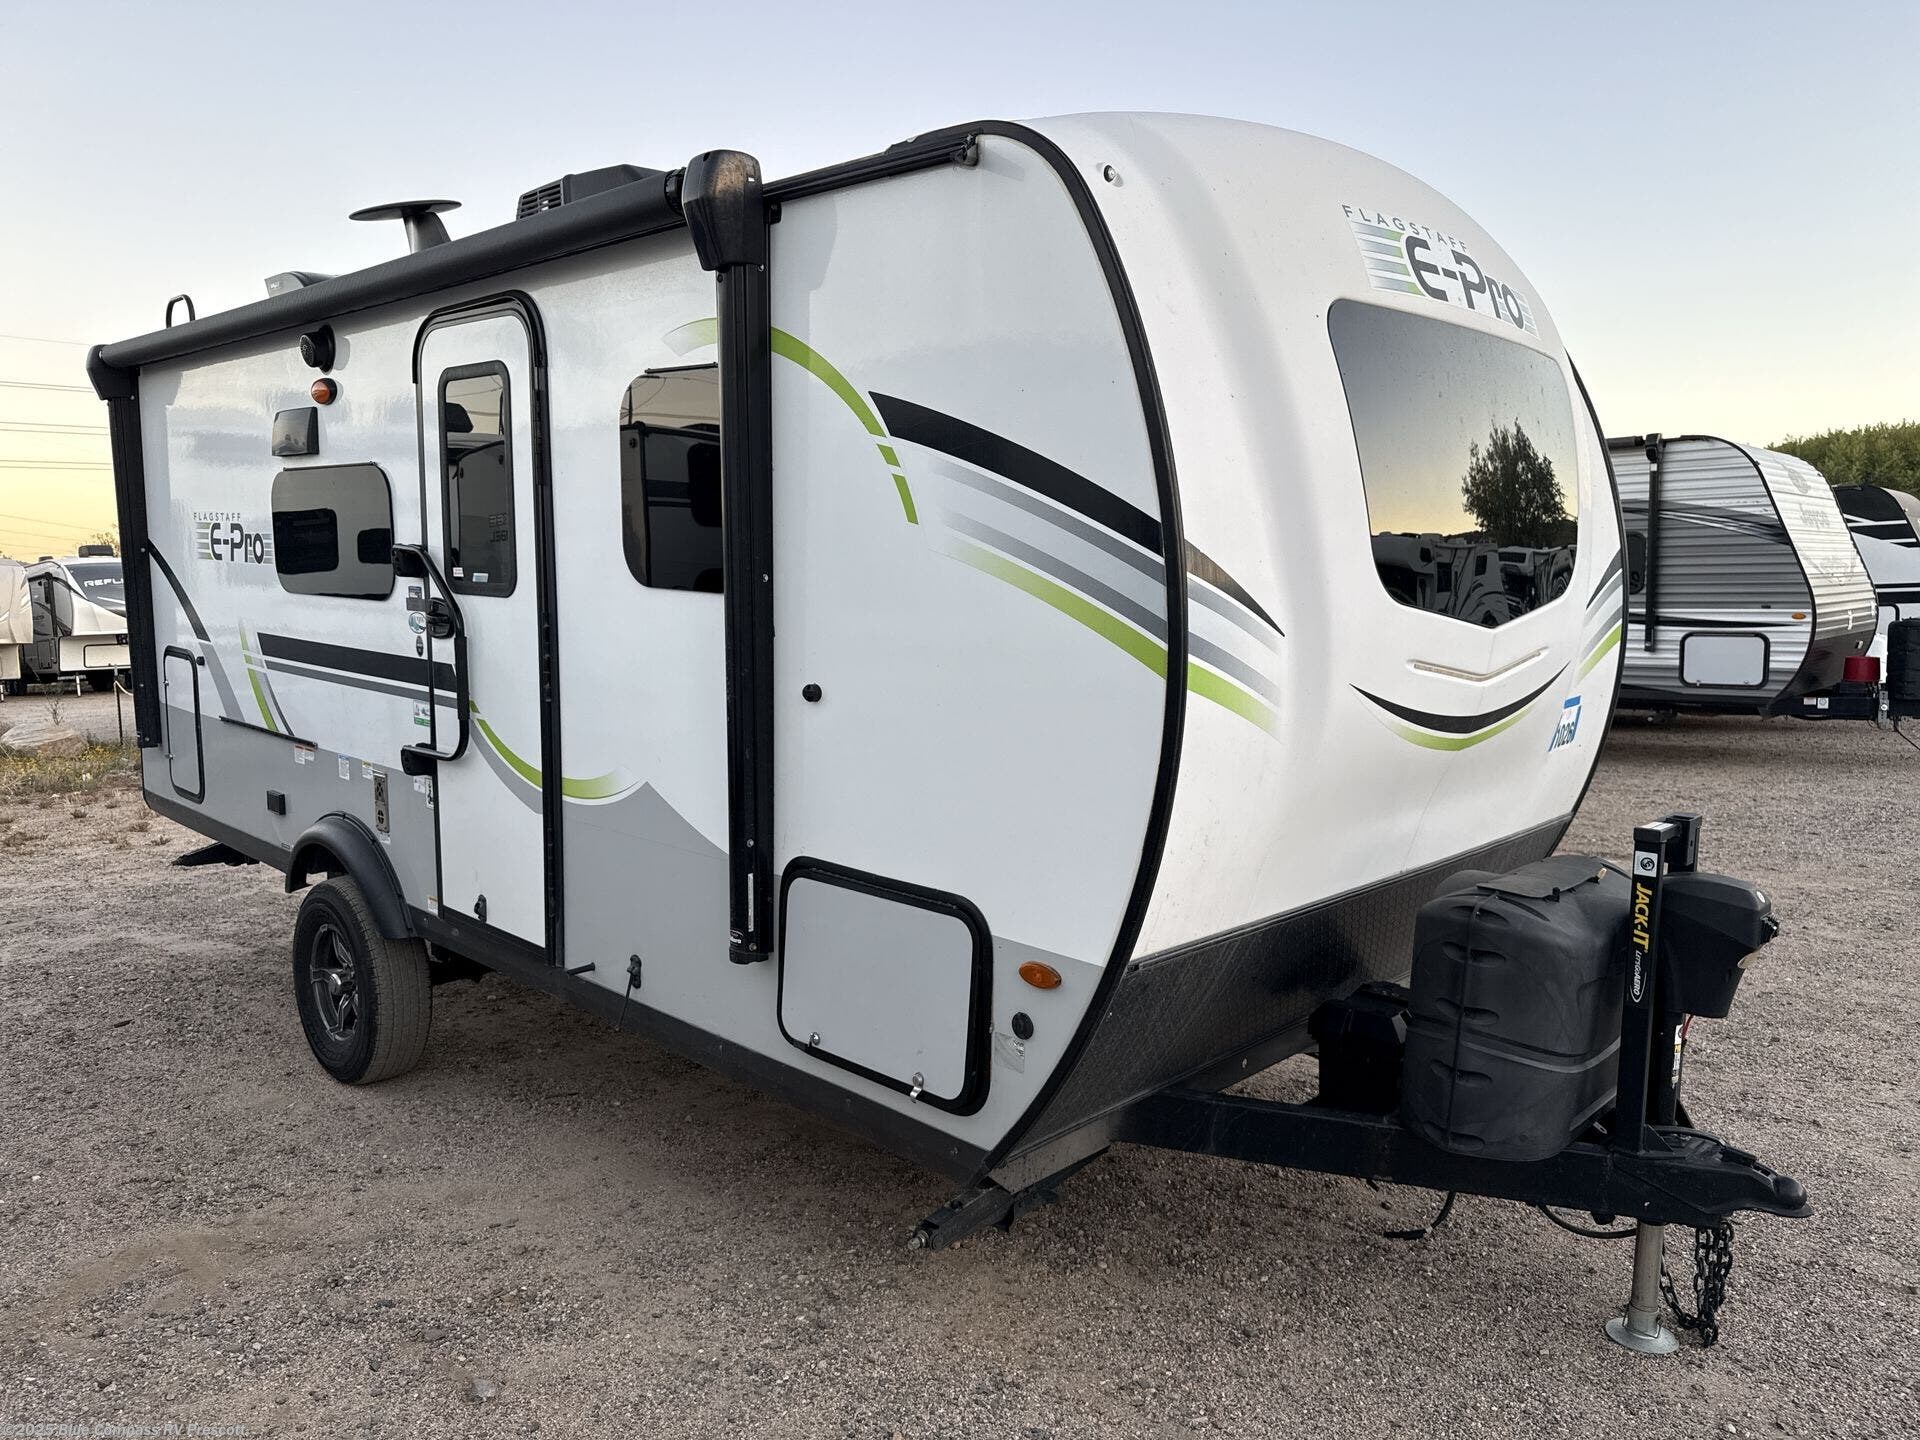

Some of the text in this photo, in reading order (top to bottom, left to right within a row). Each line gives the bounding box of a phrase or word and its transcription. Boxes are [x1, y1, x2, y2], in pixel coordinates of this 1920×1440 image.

[1341, 203, 1468, 253] FLAGSTAFF
[1404, 235, 1524, 329] E-Pro
[193, 511, 242, 521] FLAGSTAFF
[210, 521, 265, 565] E-Pro
[1632, 881, 1653, 952] JACK-IT
